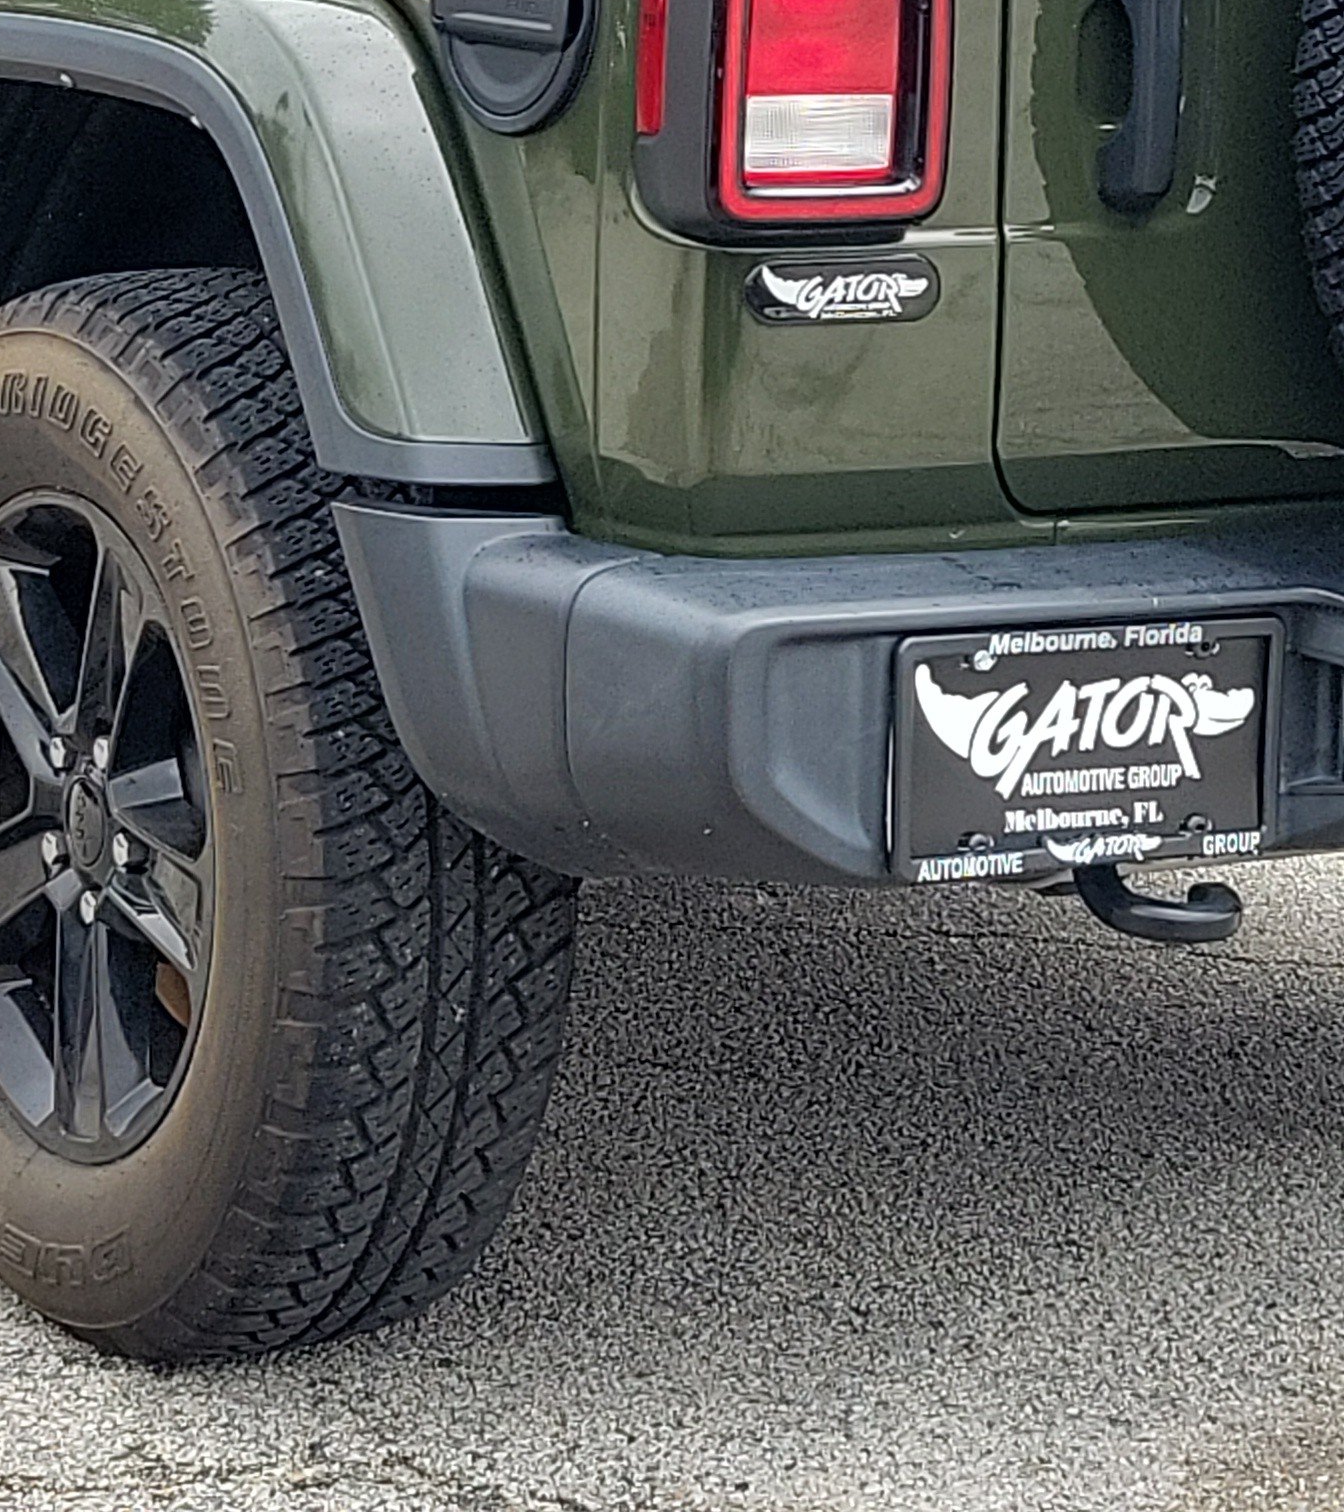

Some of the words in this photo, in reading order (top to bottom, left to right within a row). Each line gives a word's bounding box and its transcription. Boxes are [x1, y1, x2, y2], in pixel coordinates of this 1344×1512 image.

[796, 273, 902, 318] GATOR
[989, 630, 1118, 656] Melbourne,
[1124, 622, 1203, 646] Florida
[970, 673, 1202, 800] GATOR
[1021, 767, 1127, 797] AUTOMOTIVE
[1127, 764, 1183, 789] GROUP
[1004, 807, 1130, 833] Melbourne,
[1133, 801, 1164, 824] FL
[918, 852, 1024, 883] AUTOMOTIVE
[1074, 835, 1145, 863] GATOR
[1203, 831, 1261, 856] GROUP
